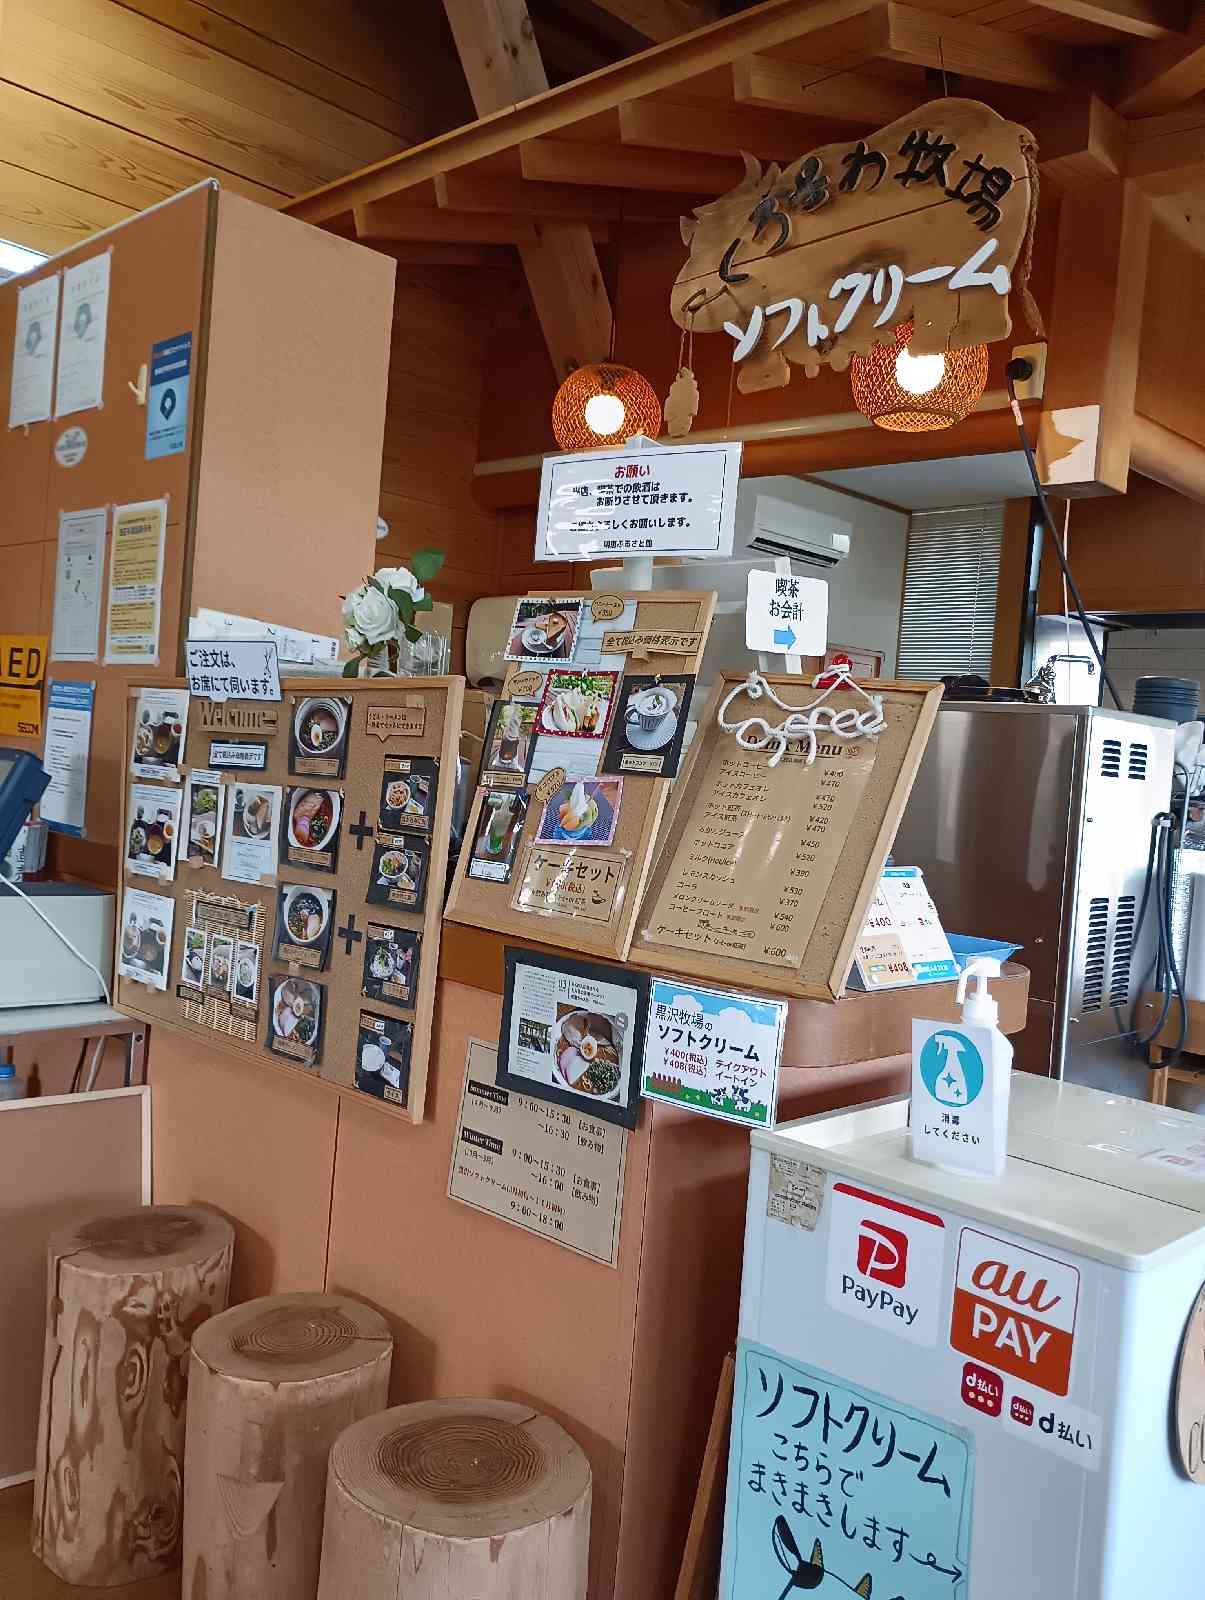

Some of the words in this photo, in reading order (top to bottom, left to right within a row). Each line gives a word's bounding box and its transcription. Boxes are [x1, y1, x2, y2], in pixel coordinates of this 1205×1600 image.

[723, 238, 1011, 363] ソフトクリーム
[615, 463, 650, 479] お願い
[596, 491, 693, 506] お断りさせて頂きます。
[775, 577, 800, 598] 喫茶
[769, 599, 804, 621] お会計
[0, 647, 41, 678] ED
[189, 650, 236, 669] ご注文は、
[191, 676, 275, 696] お席にて伺います。
[655, 1004, 713, 1031] 黒沢牧場の
[657, 1024, 760, 1061] ソフトクリーム
[715, 1060, 767, 1078] テイクアウト
[715, 1072, 758, 1087] イートイン
[924, 1124, 982, 1145] してください
[971, 1259, 1062, 1313] au
[842, 1274, 919, 1326] PayPay
[971, 1303, 1051, 1364] PAY
[966, 1373, 999, 1397] d払い
[756, 1367, 951, 1499] ソフトクリーム
[1039, 1412, 1093, 1450] d払い
[772, 1432, 864, 1498] こちらで
[748, 1460, 910, 1563] まきまきします
